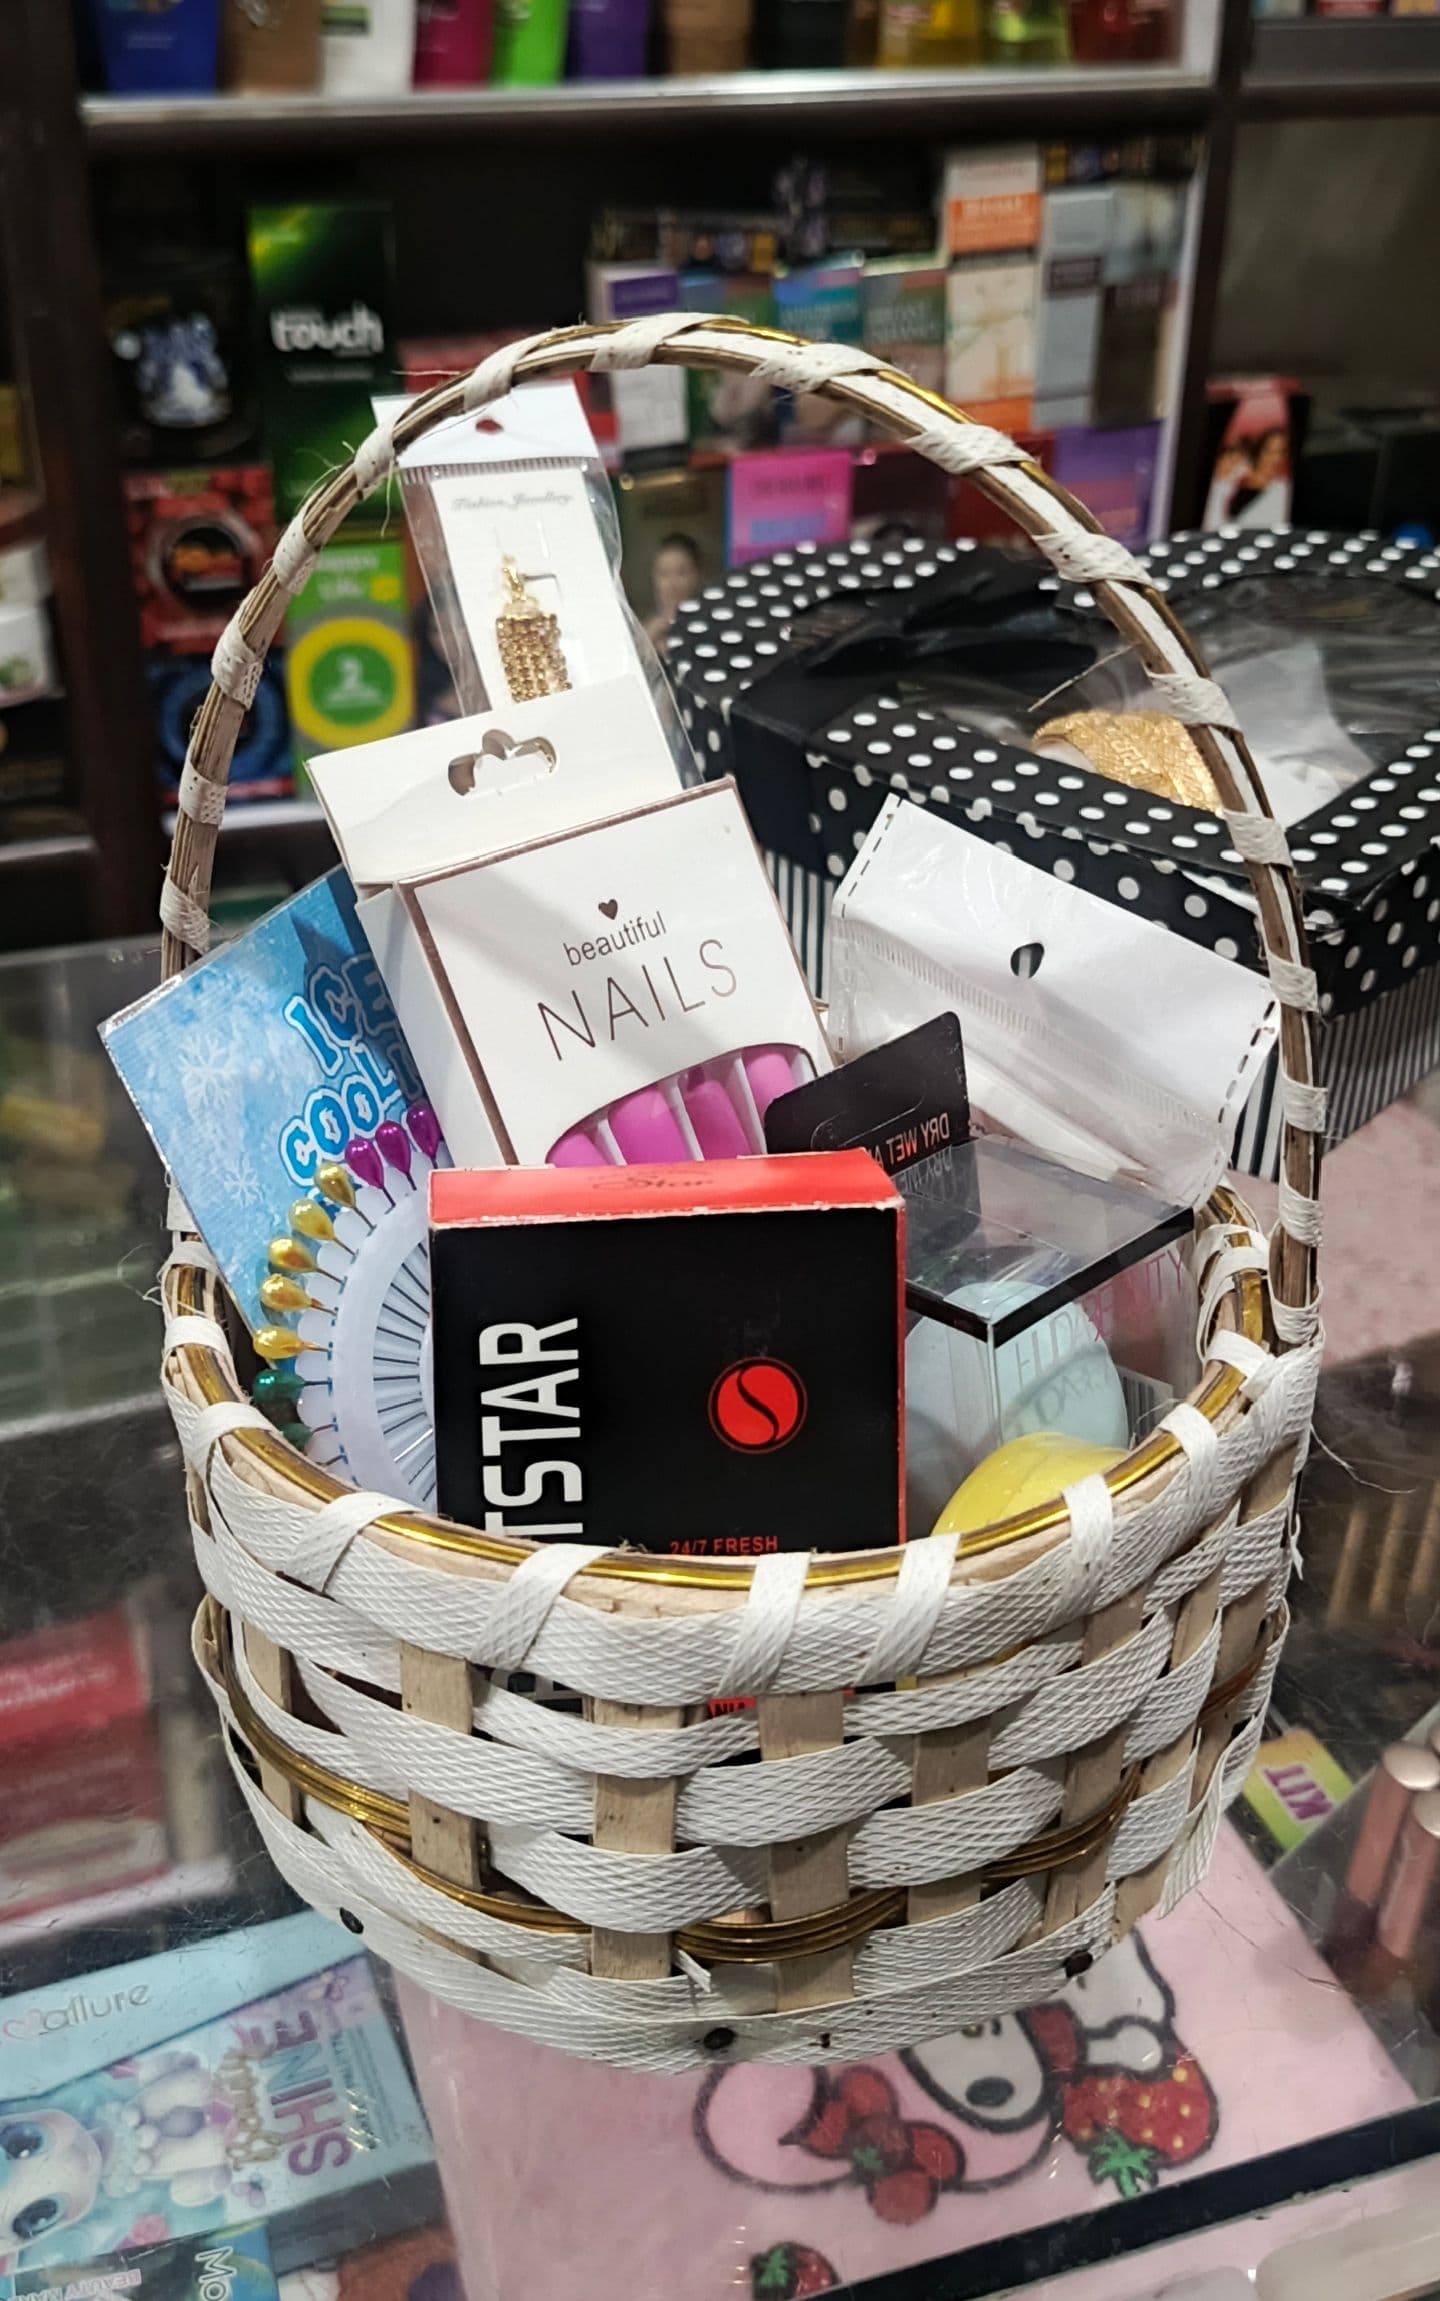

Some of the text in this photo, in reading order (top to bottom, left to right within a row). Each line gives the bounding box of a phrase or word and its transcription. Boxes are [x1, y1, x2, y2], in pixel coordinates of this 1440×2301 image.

[562, 910, 668, 967] beautiful
[284, 953, 400, 1077] ICE
[537, 938, 738, 1061] NAILS
[669, 1535, 778, 1556] 24/7 FRESH
[38, 1984, 150, 2036] allure
[262, 2010, 353, 2177] SHINE
